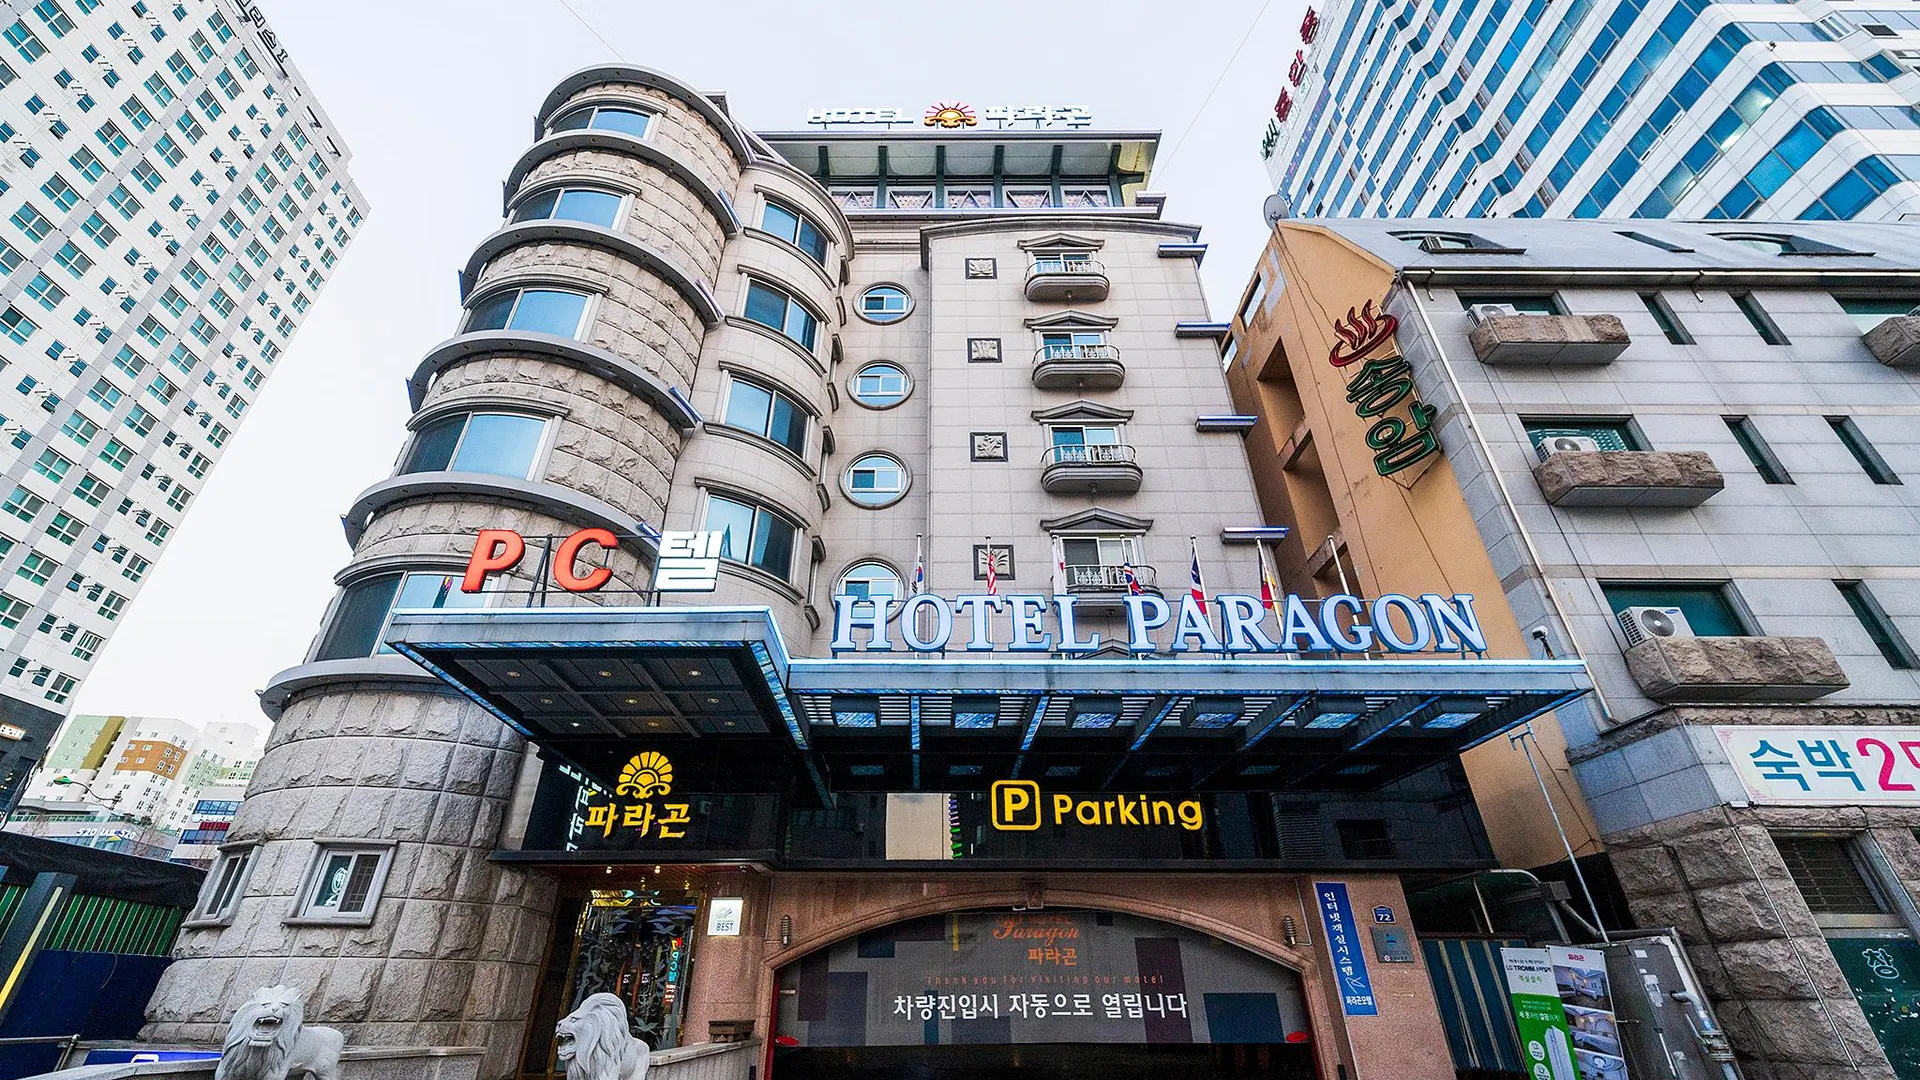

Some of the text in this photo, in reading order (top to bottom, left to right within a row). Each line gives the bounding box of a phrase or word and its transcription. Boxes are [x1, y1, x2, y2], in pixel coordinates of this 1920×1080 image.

[807, 107, 914, 125] HOTEL
[830, 593, 1488, 653] HOTEL PARAGON
[1750, 739, 1866, 792] 숙박
[584, 802, 691, 839] 파라곤
[1053, 794, 1203, 830] Parking
[716, 922, 734, 932] BEST
[1377, 913, 1392, 921] 72
[992, 918, 1080, 947] Paragon
[1027, 946, 1078, 967] 파라곤
[926, 975, 1164, 989] Thank you for visiting our motel
[894, 993, 1188, 1020] 차량진입시 자동으로 열립니다
